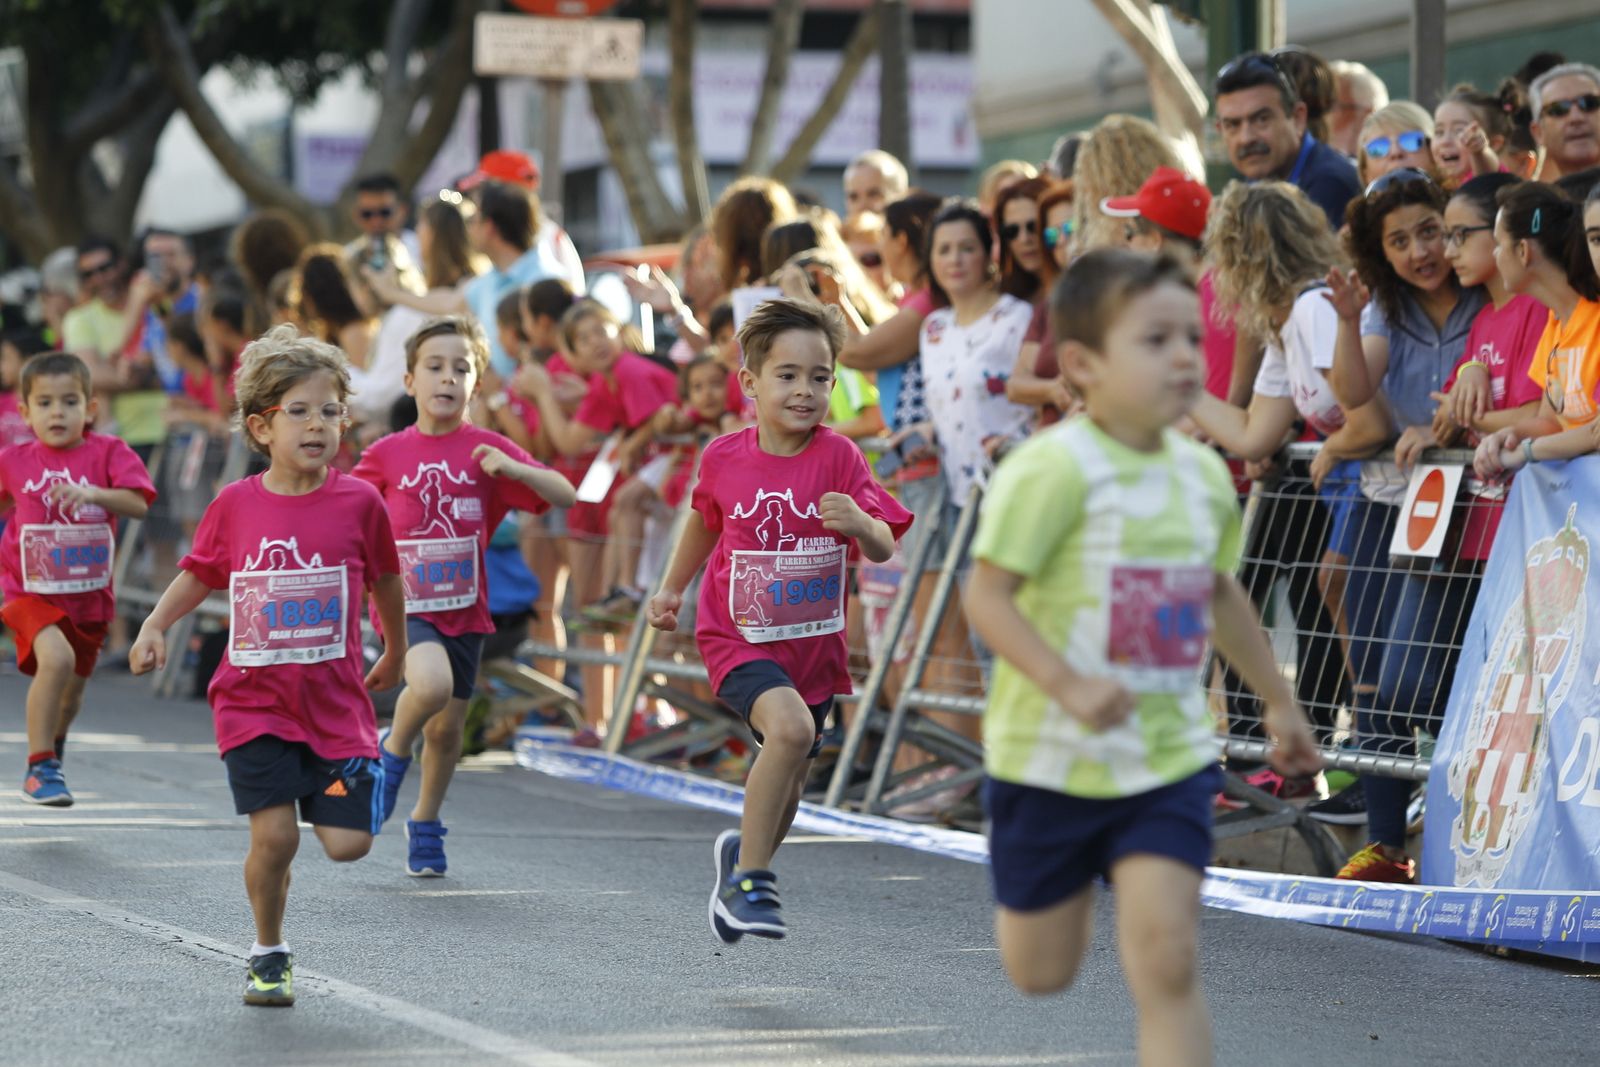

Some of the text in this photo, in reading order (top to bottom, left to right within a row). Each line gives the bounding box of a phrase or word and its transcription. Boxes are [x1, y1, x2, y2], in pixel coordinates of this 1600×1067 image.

[804, 536, 836, 547] CARRER
[413, 560, 473, 583] 1876
[780, 556, 812, 566] CARRERA
[768, 576, 839, 606] 1966
[262, 597, 341, 628] 1884
